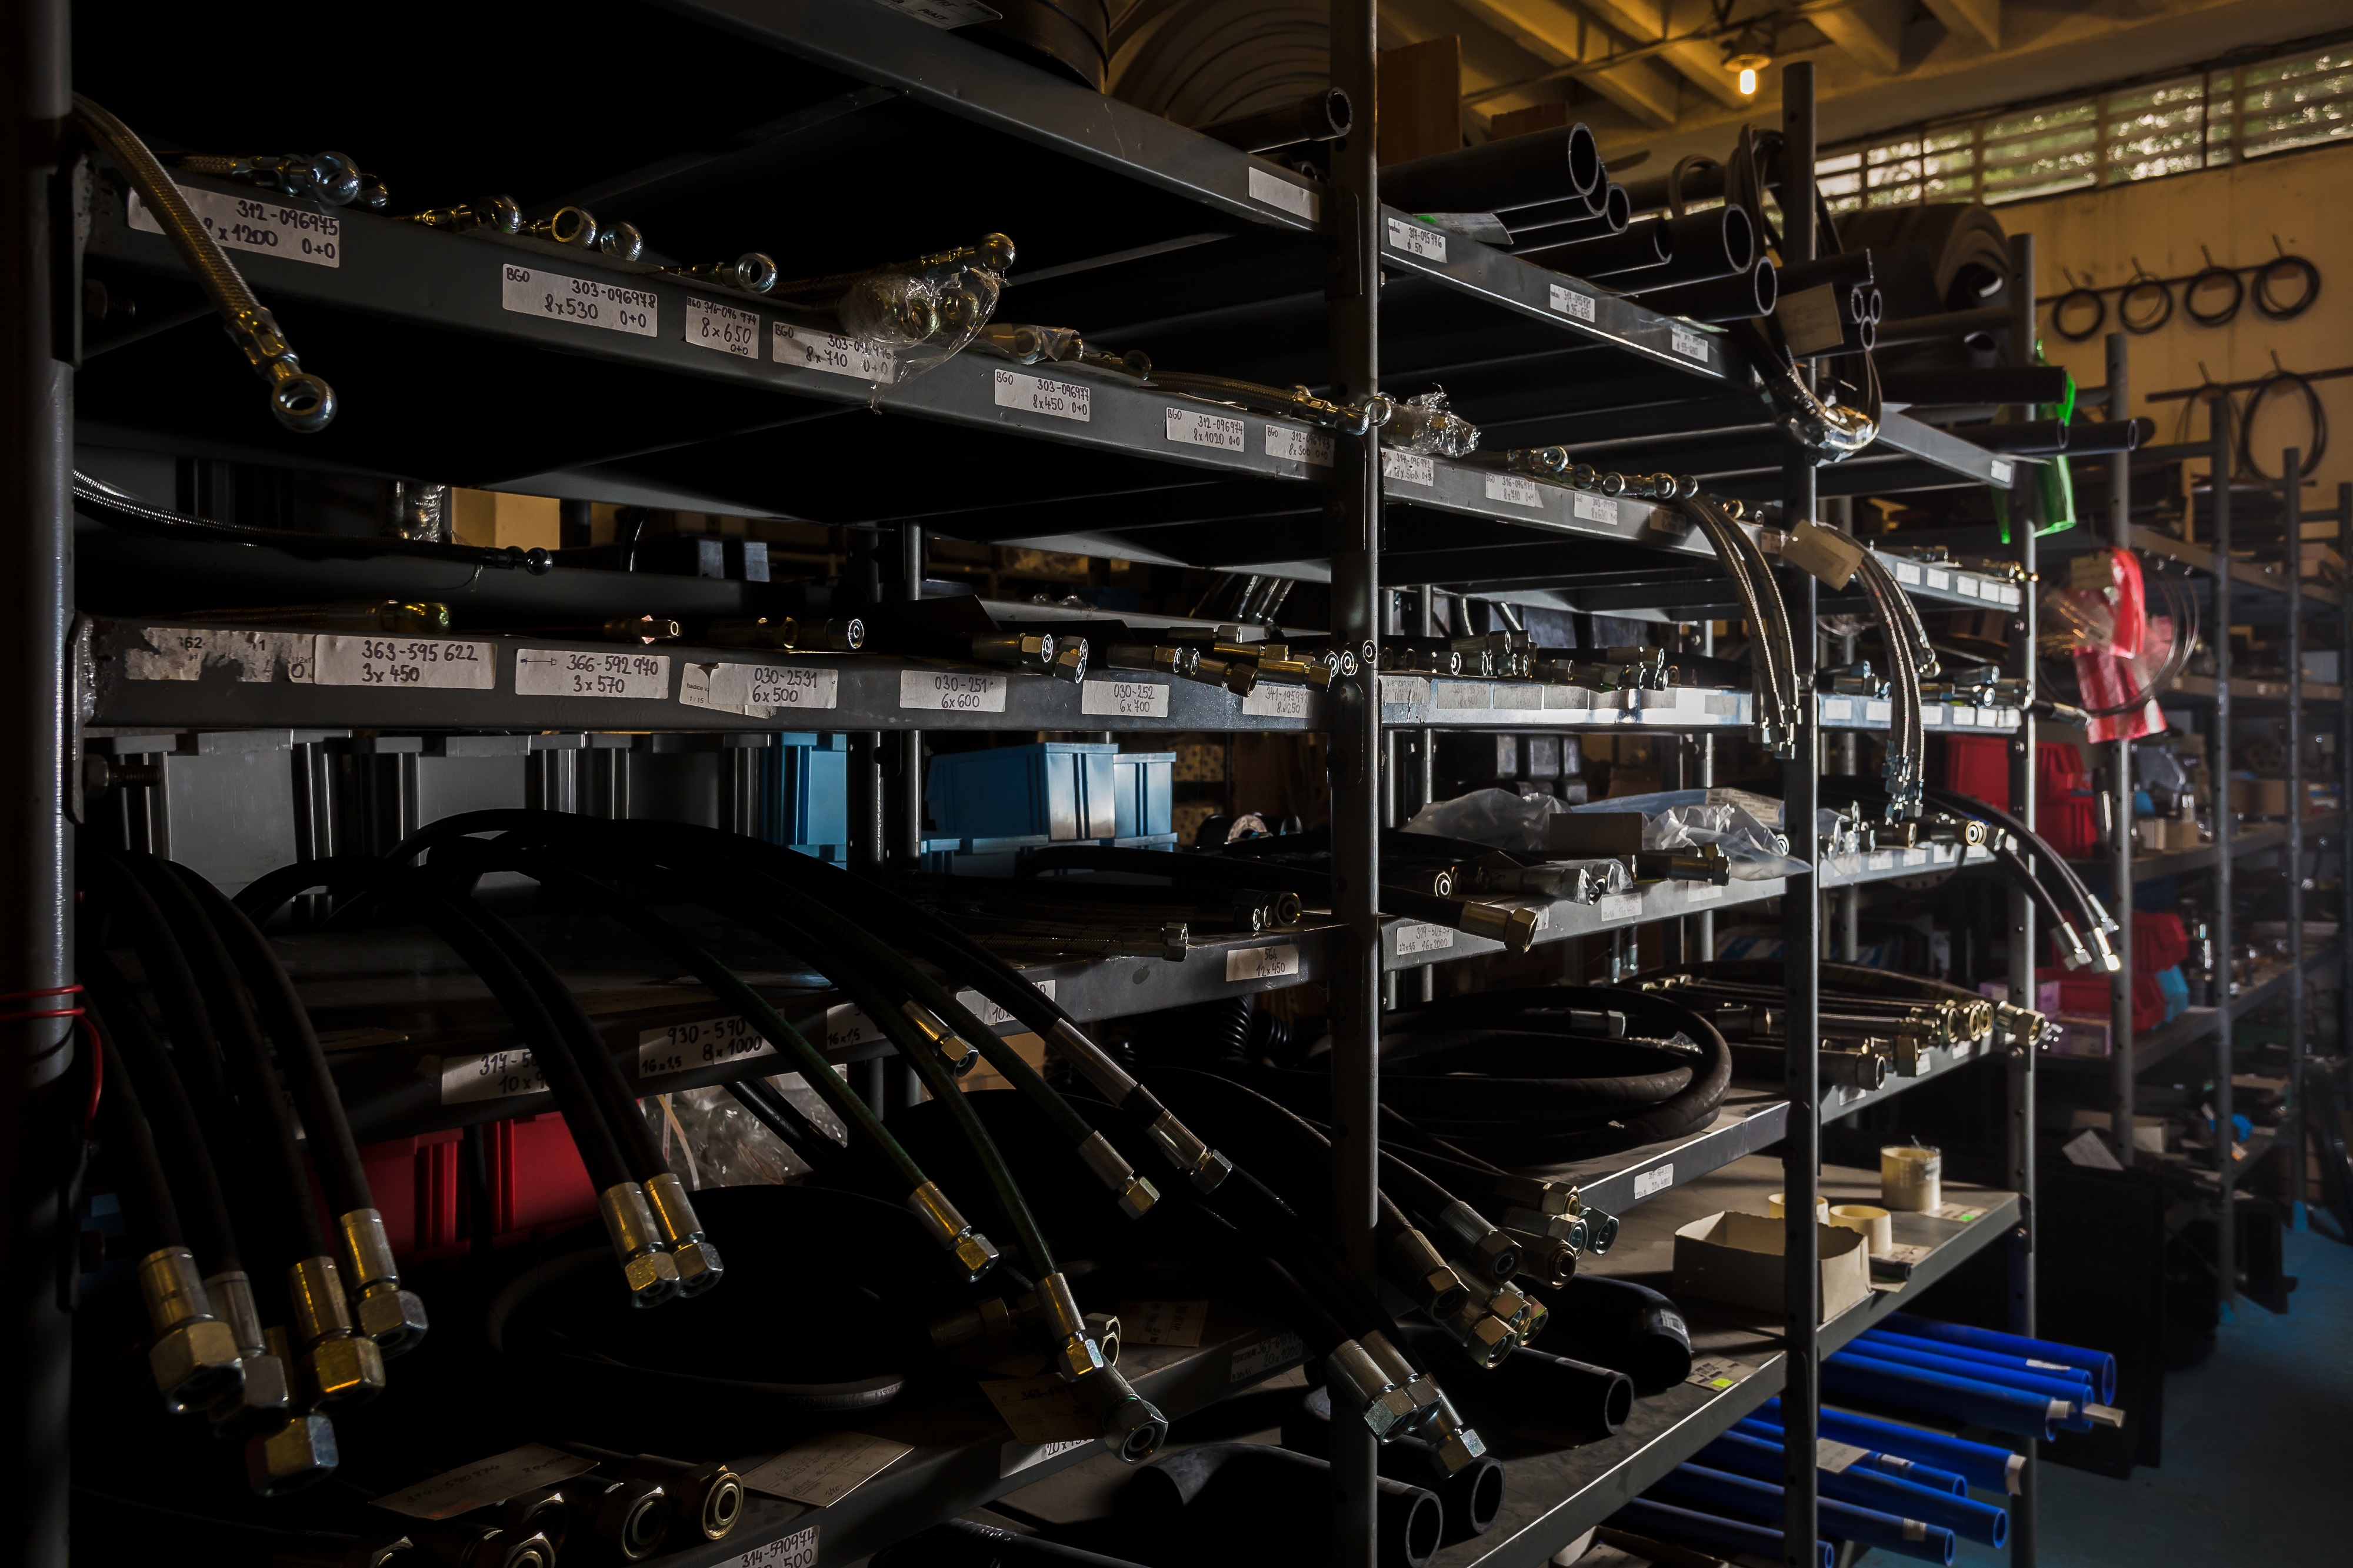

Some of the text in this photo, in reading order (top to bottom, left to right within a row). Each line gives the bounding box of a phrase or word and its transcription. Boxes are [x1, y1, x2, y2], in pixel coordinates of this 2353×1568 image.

[302, 238, 336, 259] 0+0
[1415, 242, 1423, 254] 50
[544, 293, 647, 328] 8x530 0+0
[730, 343, 749, 356] 0+0
[1032, 393, 1088, 416] 8x450 0+0
[686, 682, 704, 692] hadice
[1114, 684, 1155, 700] 030-252
[941, 693, 981, 709] 6x600
[1265, 947, 1278, 962] 564
[1256, 962, 1285, 977] 12x450
[702, 1035, 763, 1061] 8x1000
